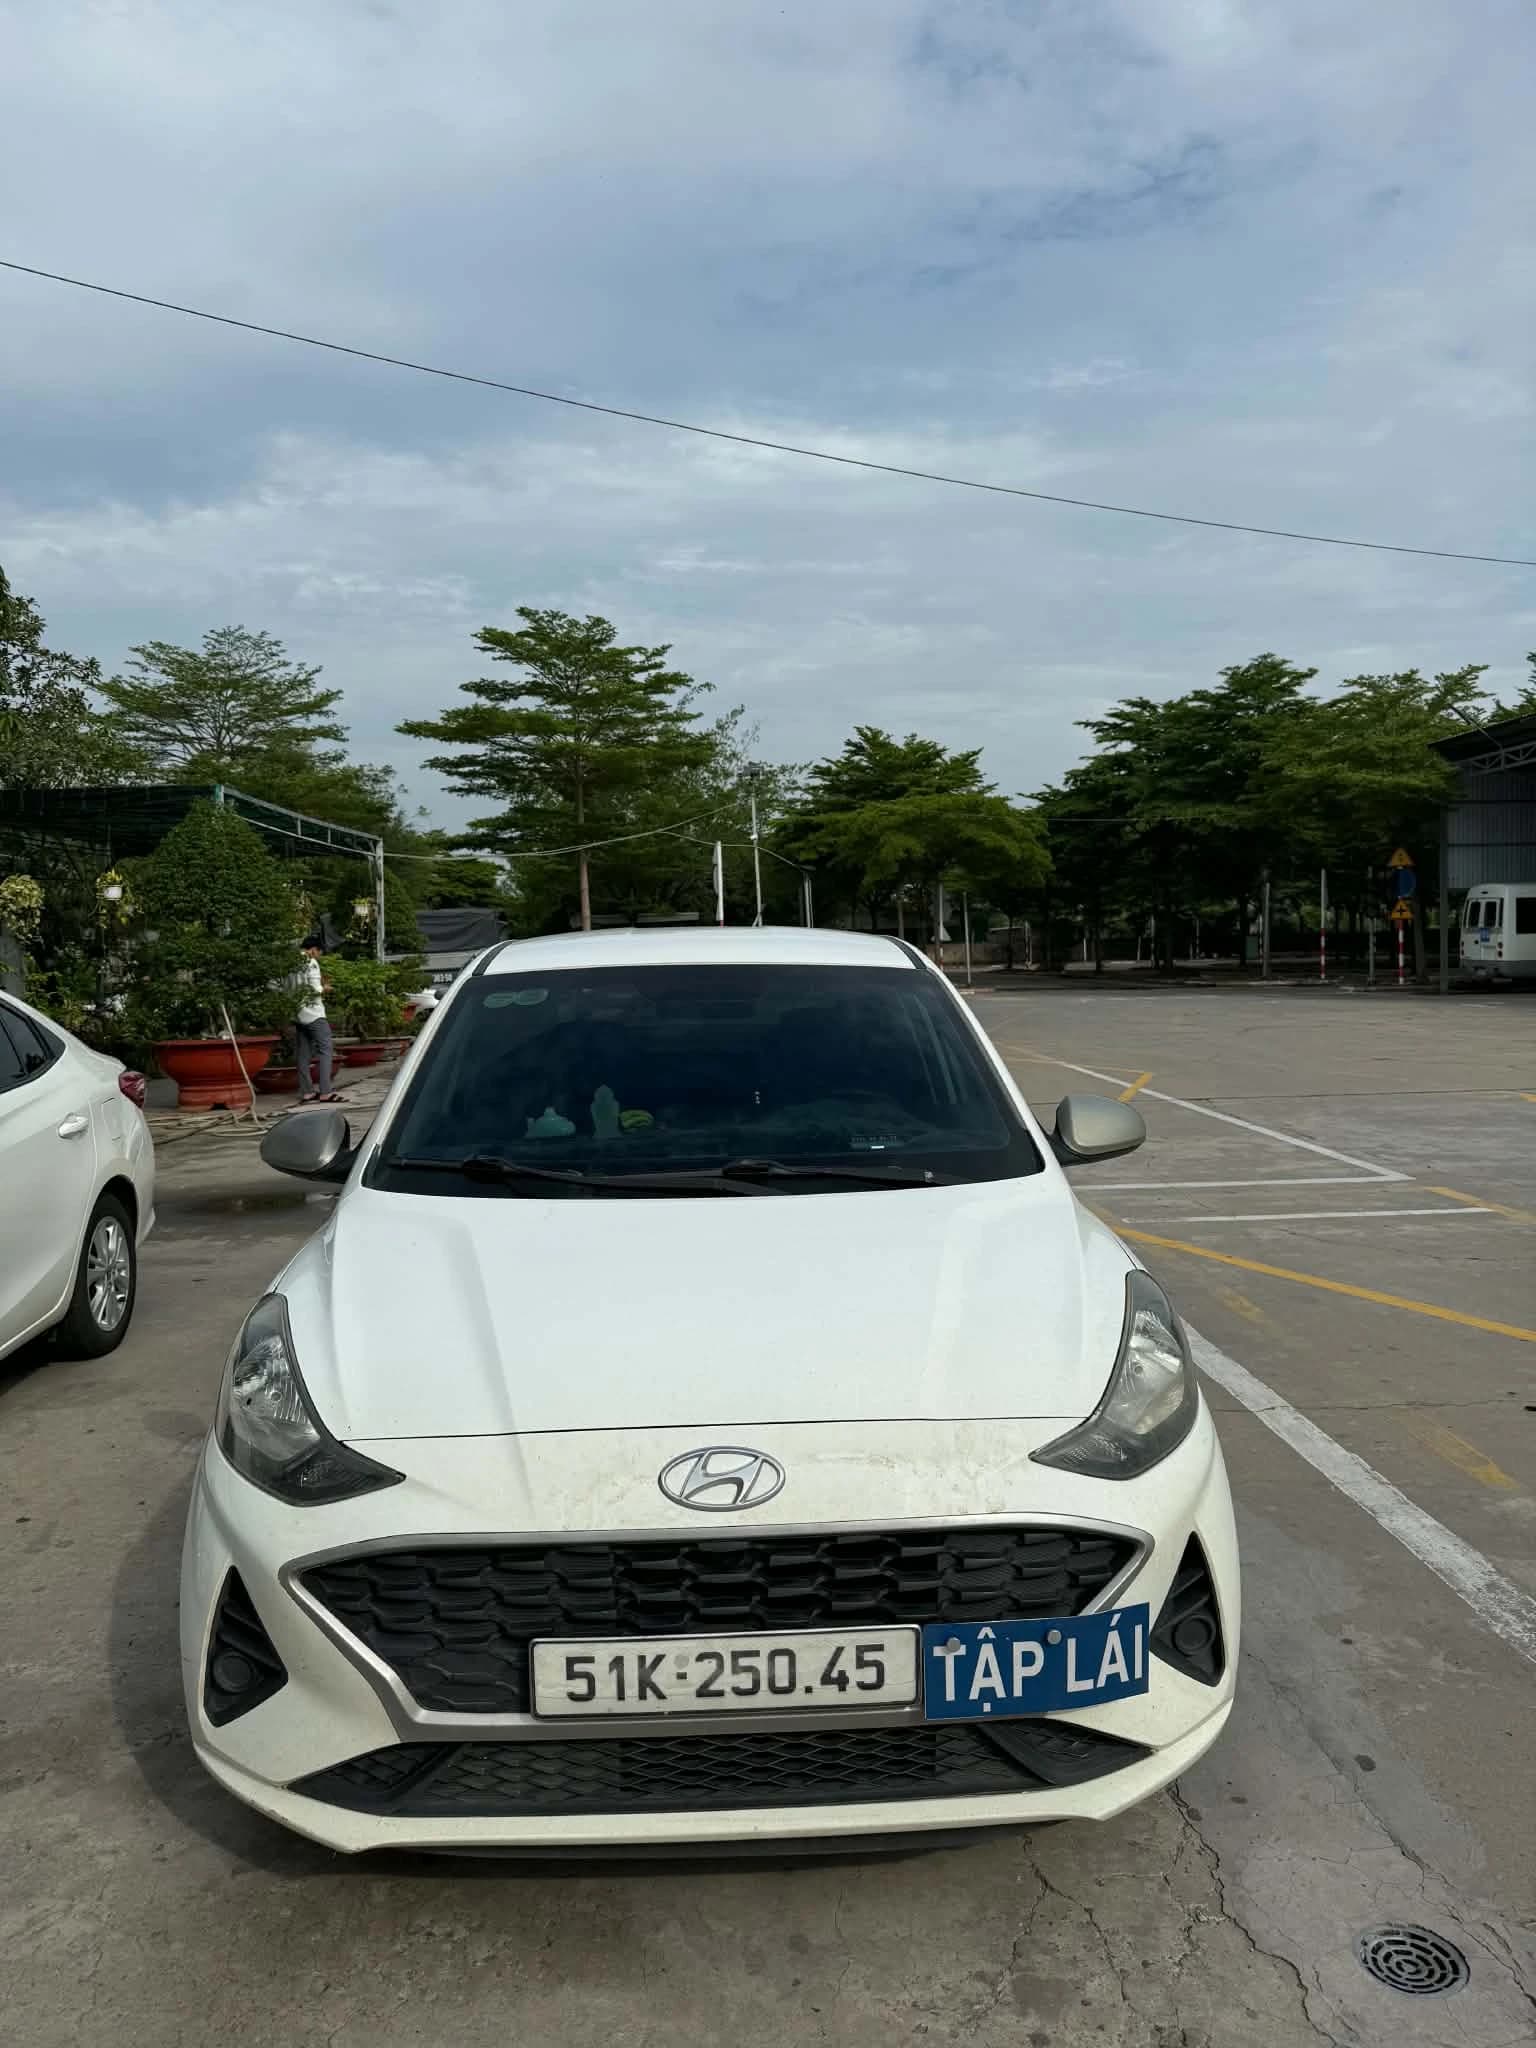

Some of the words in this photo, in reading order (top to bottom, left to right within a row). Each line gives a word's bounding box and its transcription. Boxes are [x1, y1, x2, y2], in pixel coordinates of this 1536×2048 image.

[566, 1644, 886, 1703] 51K-250.45
[933, 1627, 1044, 1712] TẬP
[1067, 1613, 1142, 1693] LÁI
